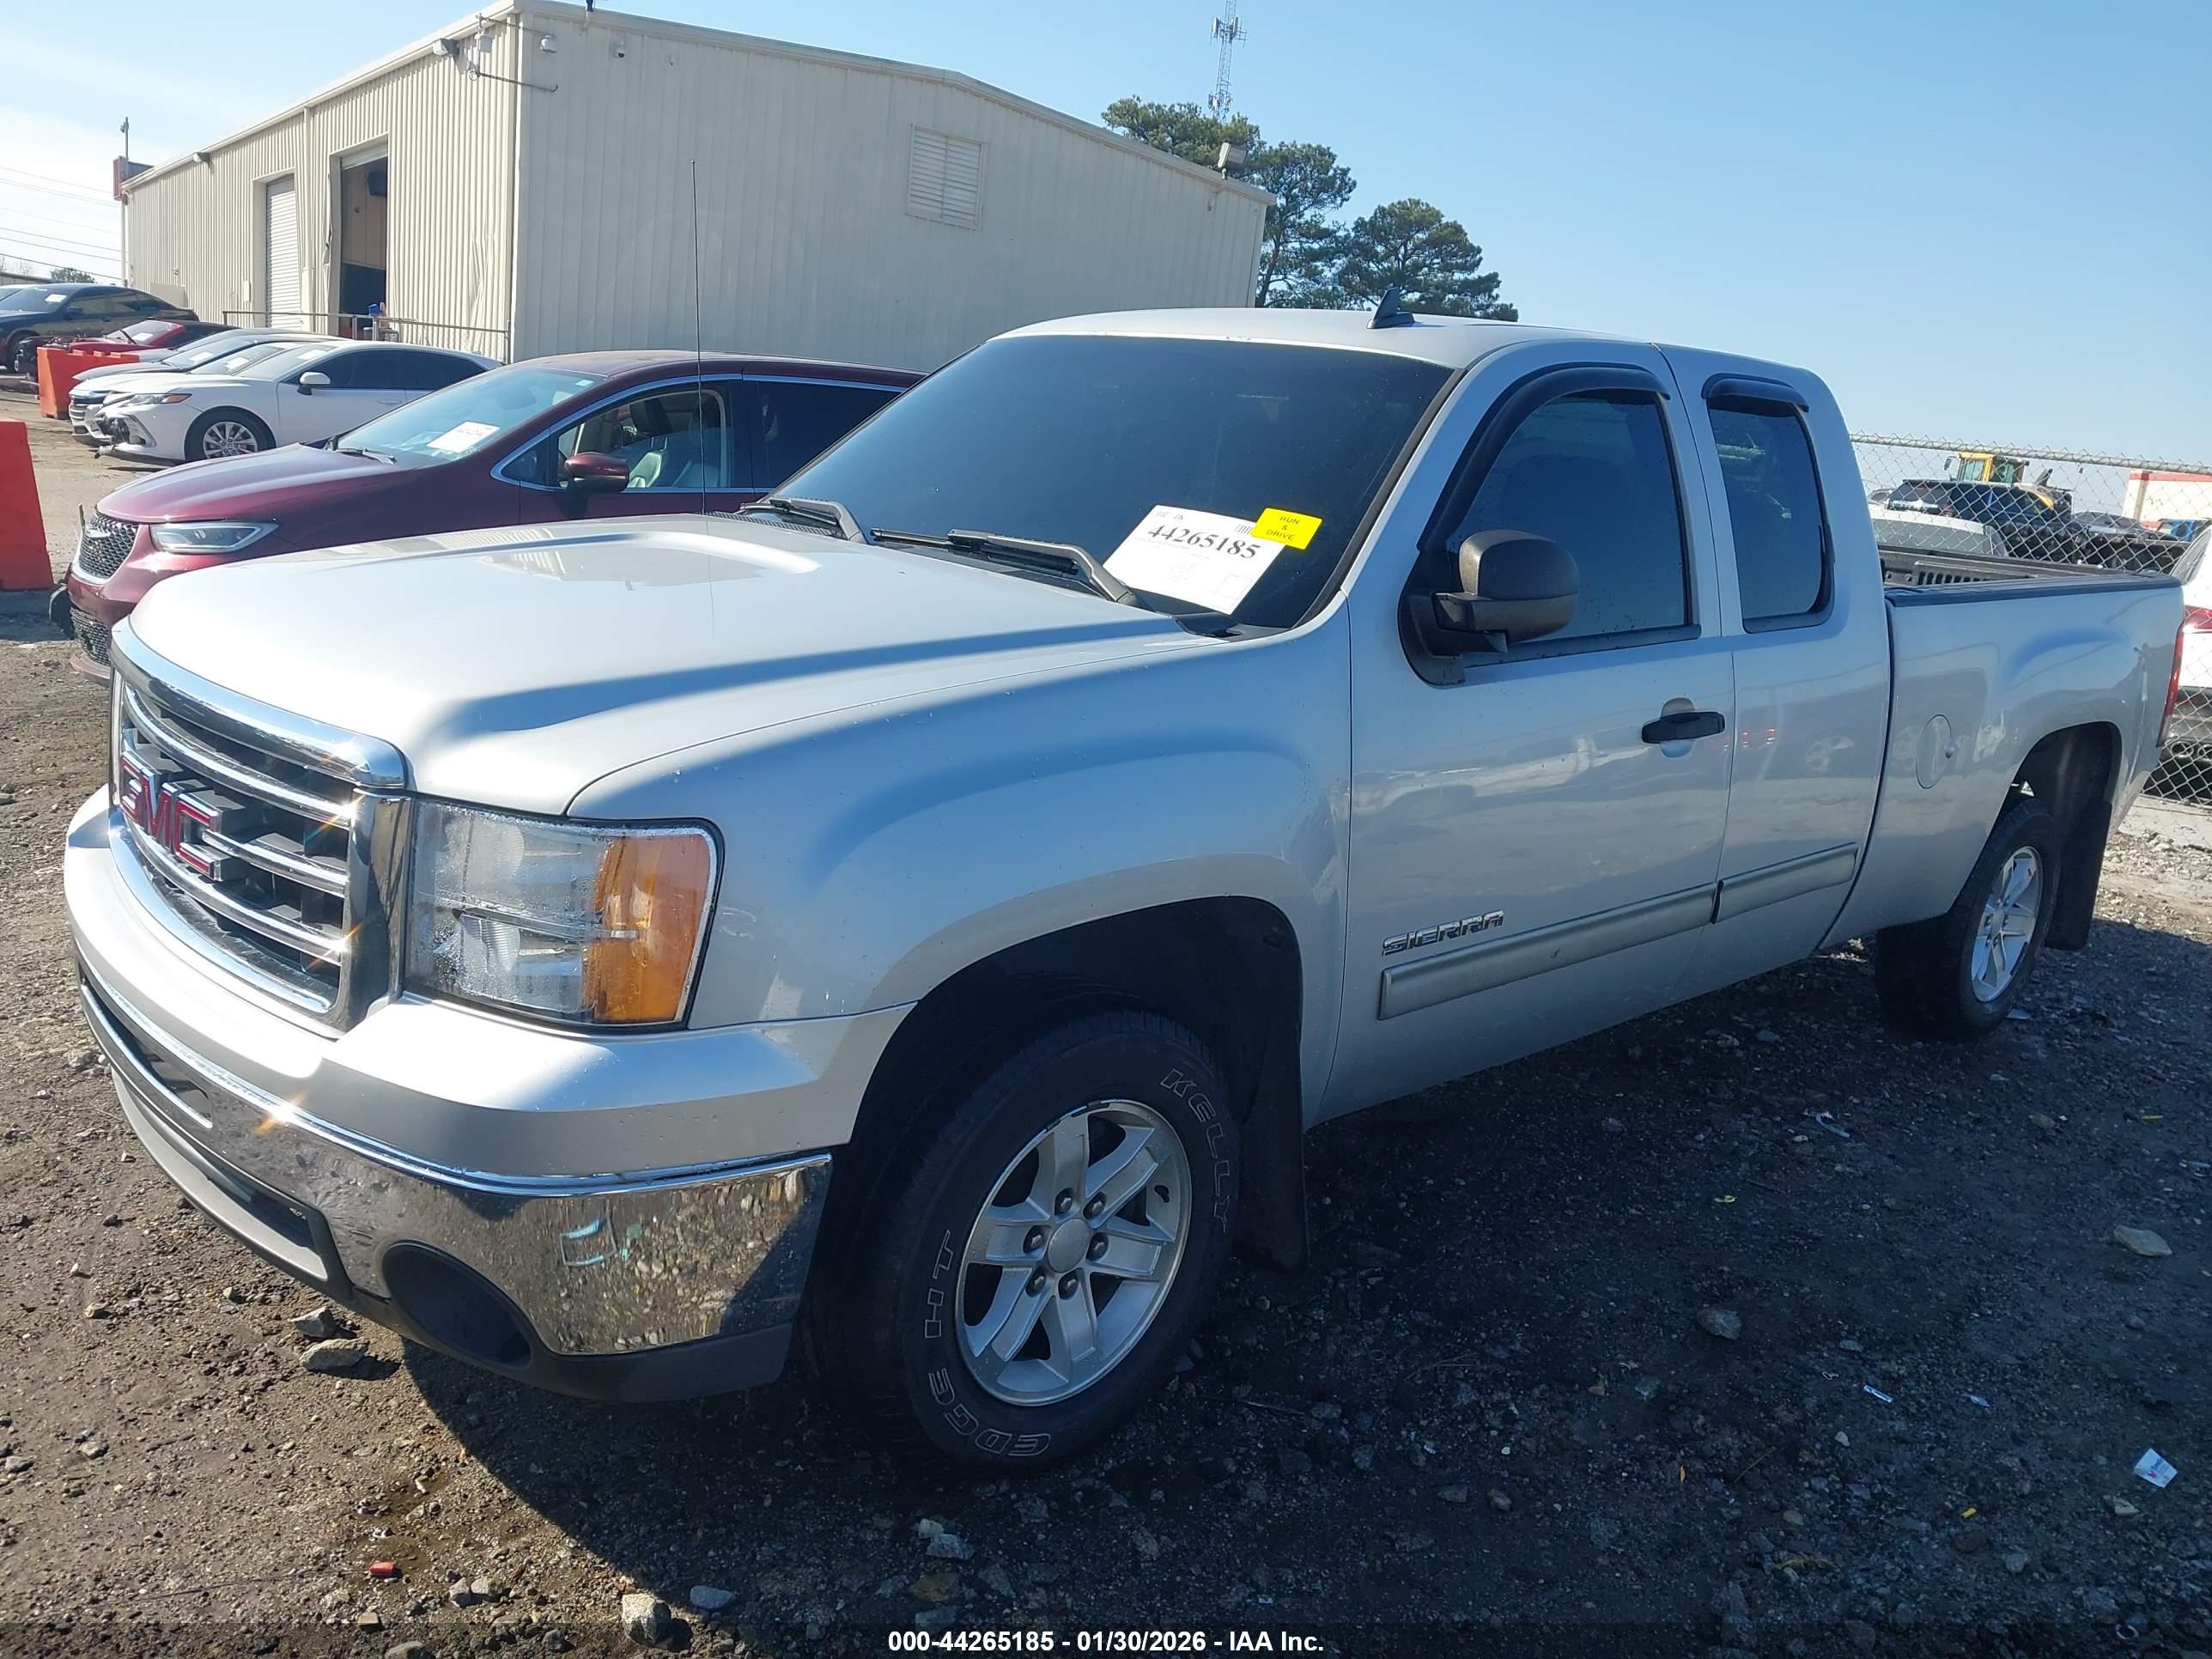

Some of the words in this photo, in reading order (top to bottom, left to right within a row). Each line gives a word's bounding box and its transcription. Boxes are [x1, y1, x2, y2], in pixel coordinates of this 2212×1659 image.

[1148, 524, 1261, 559] 44265185
[1266, 530, 1296, 541] DRIVE
[1279, 515, 1301, 525] RUN
[118, 750, 223, 883] GMC
[1381, 909, 1505, 957] SIERRA
[1159, 1067, 1231, 1235] KELLY
[927, 1367, 1052, 1456] EDGE
